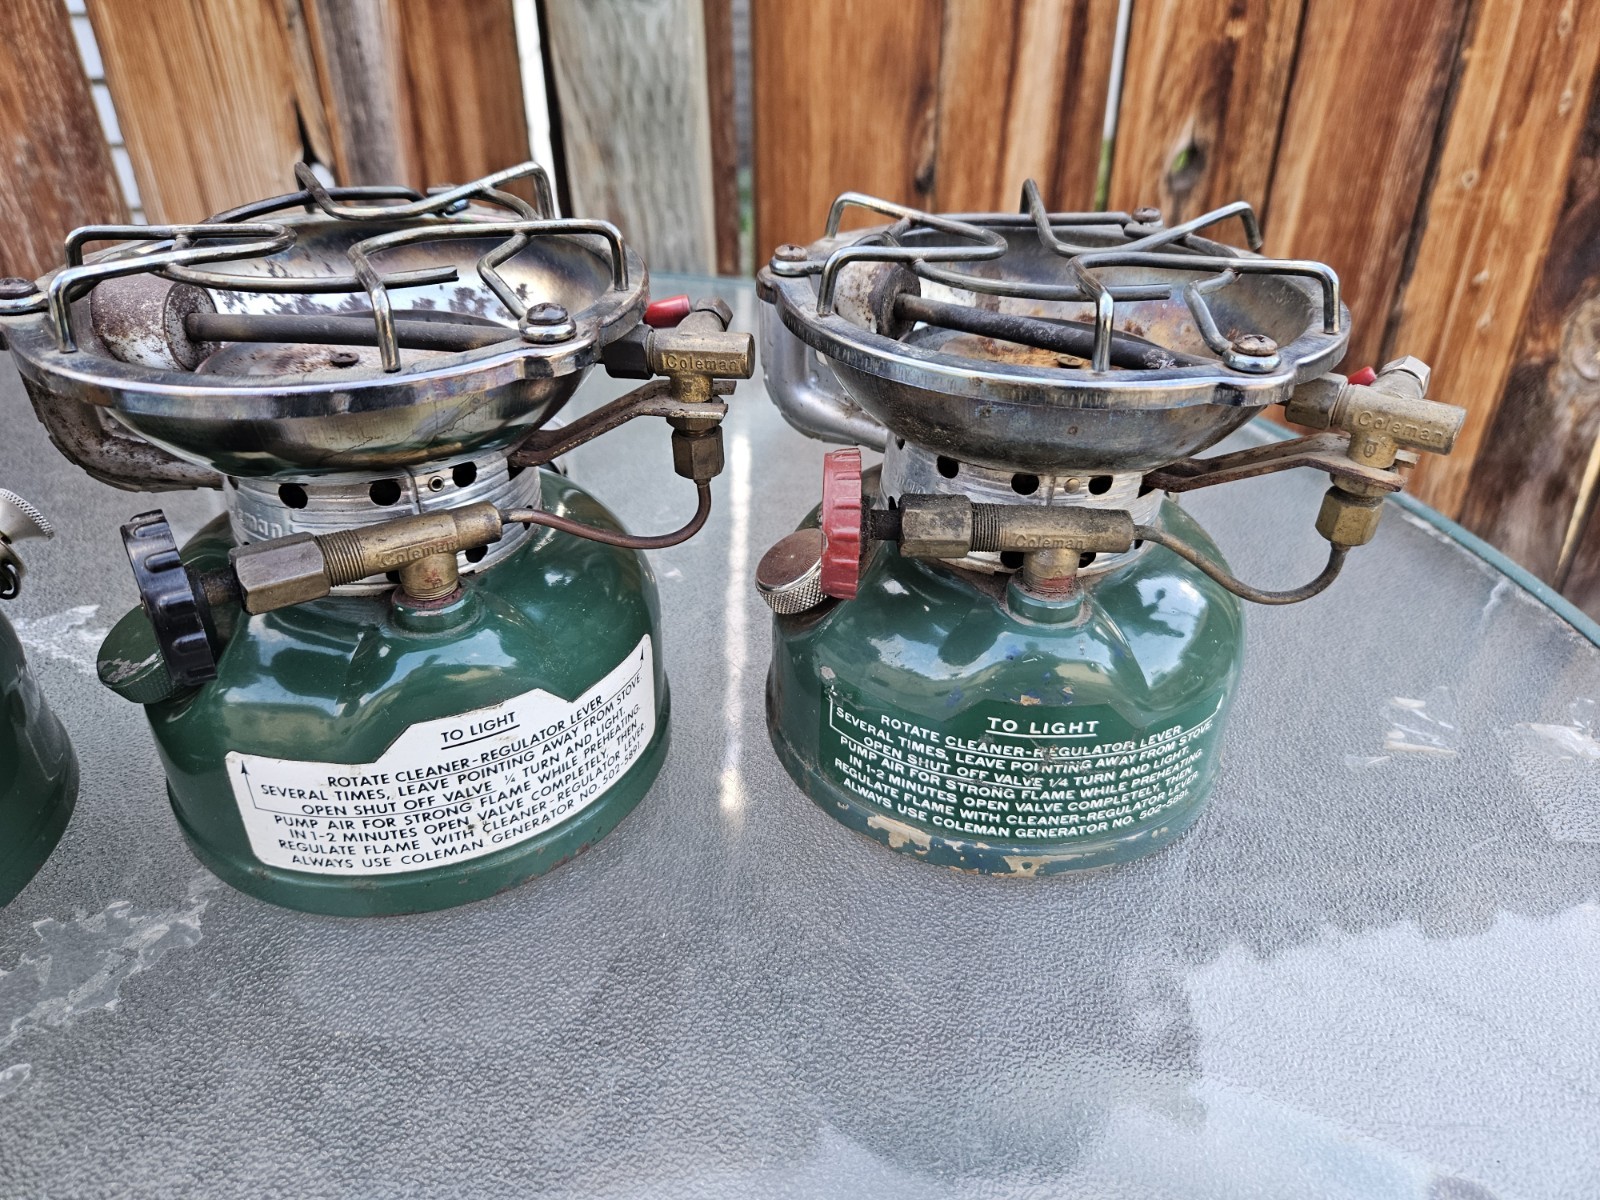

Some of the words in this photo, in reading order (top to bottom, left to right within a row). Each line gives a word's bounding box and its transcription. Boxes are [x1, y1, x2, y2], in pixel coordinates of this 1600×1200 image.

[666, 354, 738, 371] Coleman
[1358, 410, 1443, 444] Coleman
[380, 540, 458, 567] Coleman
[1015, 534, 1086, 550] Coleman
[260, 784, 328, 801] SEVERAL
[335, 789, 390, 801] TIMES,
[398, 777, 449, 797] LEAVE
[457, 750, 535, 784] POINTING
[542, 726, 578, 755] AWAY
[583, 702, 614, 731] FROM
[616, 673, 643, 705] STOVE.
[328, 774, 390, 788] ROTATE
[395, 720, 565, 782] CLEANER-REGULATOR
[570, 695, 603, 725] LEVER
[441, 729, 463, 743] TO
[470, 711, 516, 736] LIGHT
[836, 707, 894, 744] SEVERAL
[956, 753, 1006, 770] LEAVE
[1010, 760, 1092, 774] POINTING
[1095, 753, 1137, 768] AWAY
[1139, 741, 1176, 761] FROM
[1179, 719, 1213, 746] STOVE.
[880, 714, 940, 743] ROTATE
[945, 736, 1136, 758] CLEANER-REGULATOR
[1140, 725, 1182, 748] LEVER
[987, 716, 1018, 732] TO
[1029, 720, 1100, 734] LIGHT
[274, 815, 319, 829] PUMP
[328, 818, 355, 830] AIR
[362, 818, 396, 830] FOR
[404, 802, 473, 826] STRONG
[480, 781, 531, 808] FLAME
[537, 756, 578, 784] WHILE
[583, 704, 641, 759] PREHEATING.
[278, 838, 356, 856] REGULATE
[364, 840, 420, 856] FLAME
[431, 829, 474, 846] WITH
[482, 750, 620, 834] CLEANER-REGULATOR
[624, 722, 647, 753] LEVER.
[289, 828, 307, 840] IN
[310, 831, 337, 843] 1-2
[343, 827, 418, 843] MINUTES
[424, 816, 469, 835] OPEN
[477, 797, 524, 822] VALVE
[531, 749, 609, 801] COMPLETELY,
[616, 719, 637, 746] THEN
[301, 804, 347, 816] OPEN
[355, 802, 397, 816] SHUT
[403, 796, 435, 810] OFF
[442, 781, 492, 802] VALVE
[522, 753, 560, 777] TURN
[565, 734, 592, 757] AND
[596, 706, 626, 737] LIGHT.
[834, 757, 899, 799] REGULATE
[904, 792, 955, 816] FLAME
[960, 808, 1000, 824] WITH
[1006, 791, 1165, 825] CLEANER-REGULATOR
[840, 736, 878, 761] PUMP
[881, 758, 905, 774] AIR
[910, 767, 941, 786] FOR
[946, 779, 1015, 800] STRONG
[1021, 790, 1076, 801] FLAME
[1080, 781, 1128, 799] WHILE
[850, 755, 862, 769] IN
[866, 764, 885, 779] 1-2
[889, 775, 957, 804] MINUTES
[963, 797, 1009, 812] OPEN
[1015, 802, 1063, 813] VALVE
[1165, 765, 1193, 787] THEN
[864, 736, 902, 760] OPEN
[907, 753, 951, 774] SHUT
[956, 767, 989, 781] OFF
[994, 772, 1044, 787] VALVE
[1049, 777, 1069, 788] 1/4
[1074, 771, 1116, 787] TURN
[1119, 763, 1150, 778] AND
[1153, 746, 1190, 769] LIGHT.
[292, 855, 354, 869] ALWAYS
[362, 857, 392, 868] USE
[400, 838, 484, 865] COLEMAN
[491, 799, 574, 844] GENERATOR
[579, 783, 601, 802] NO.
[843, 778, 893, 808] ALWAYS
[897, 803, 928, 822] USE
[933, 816, 1010, 838] COLEMAN
[1015, 822, 1109, 838] GENERATOR
[1112, 814, 1135, 828] NO.
